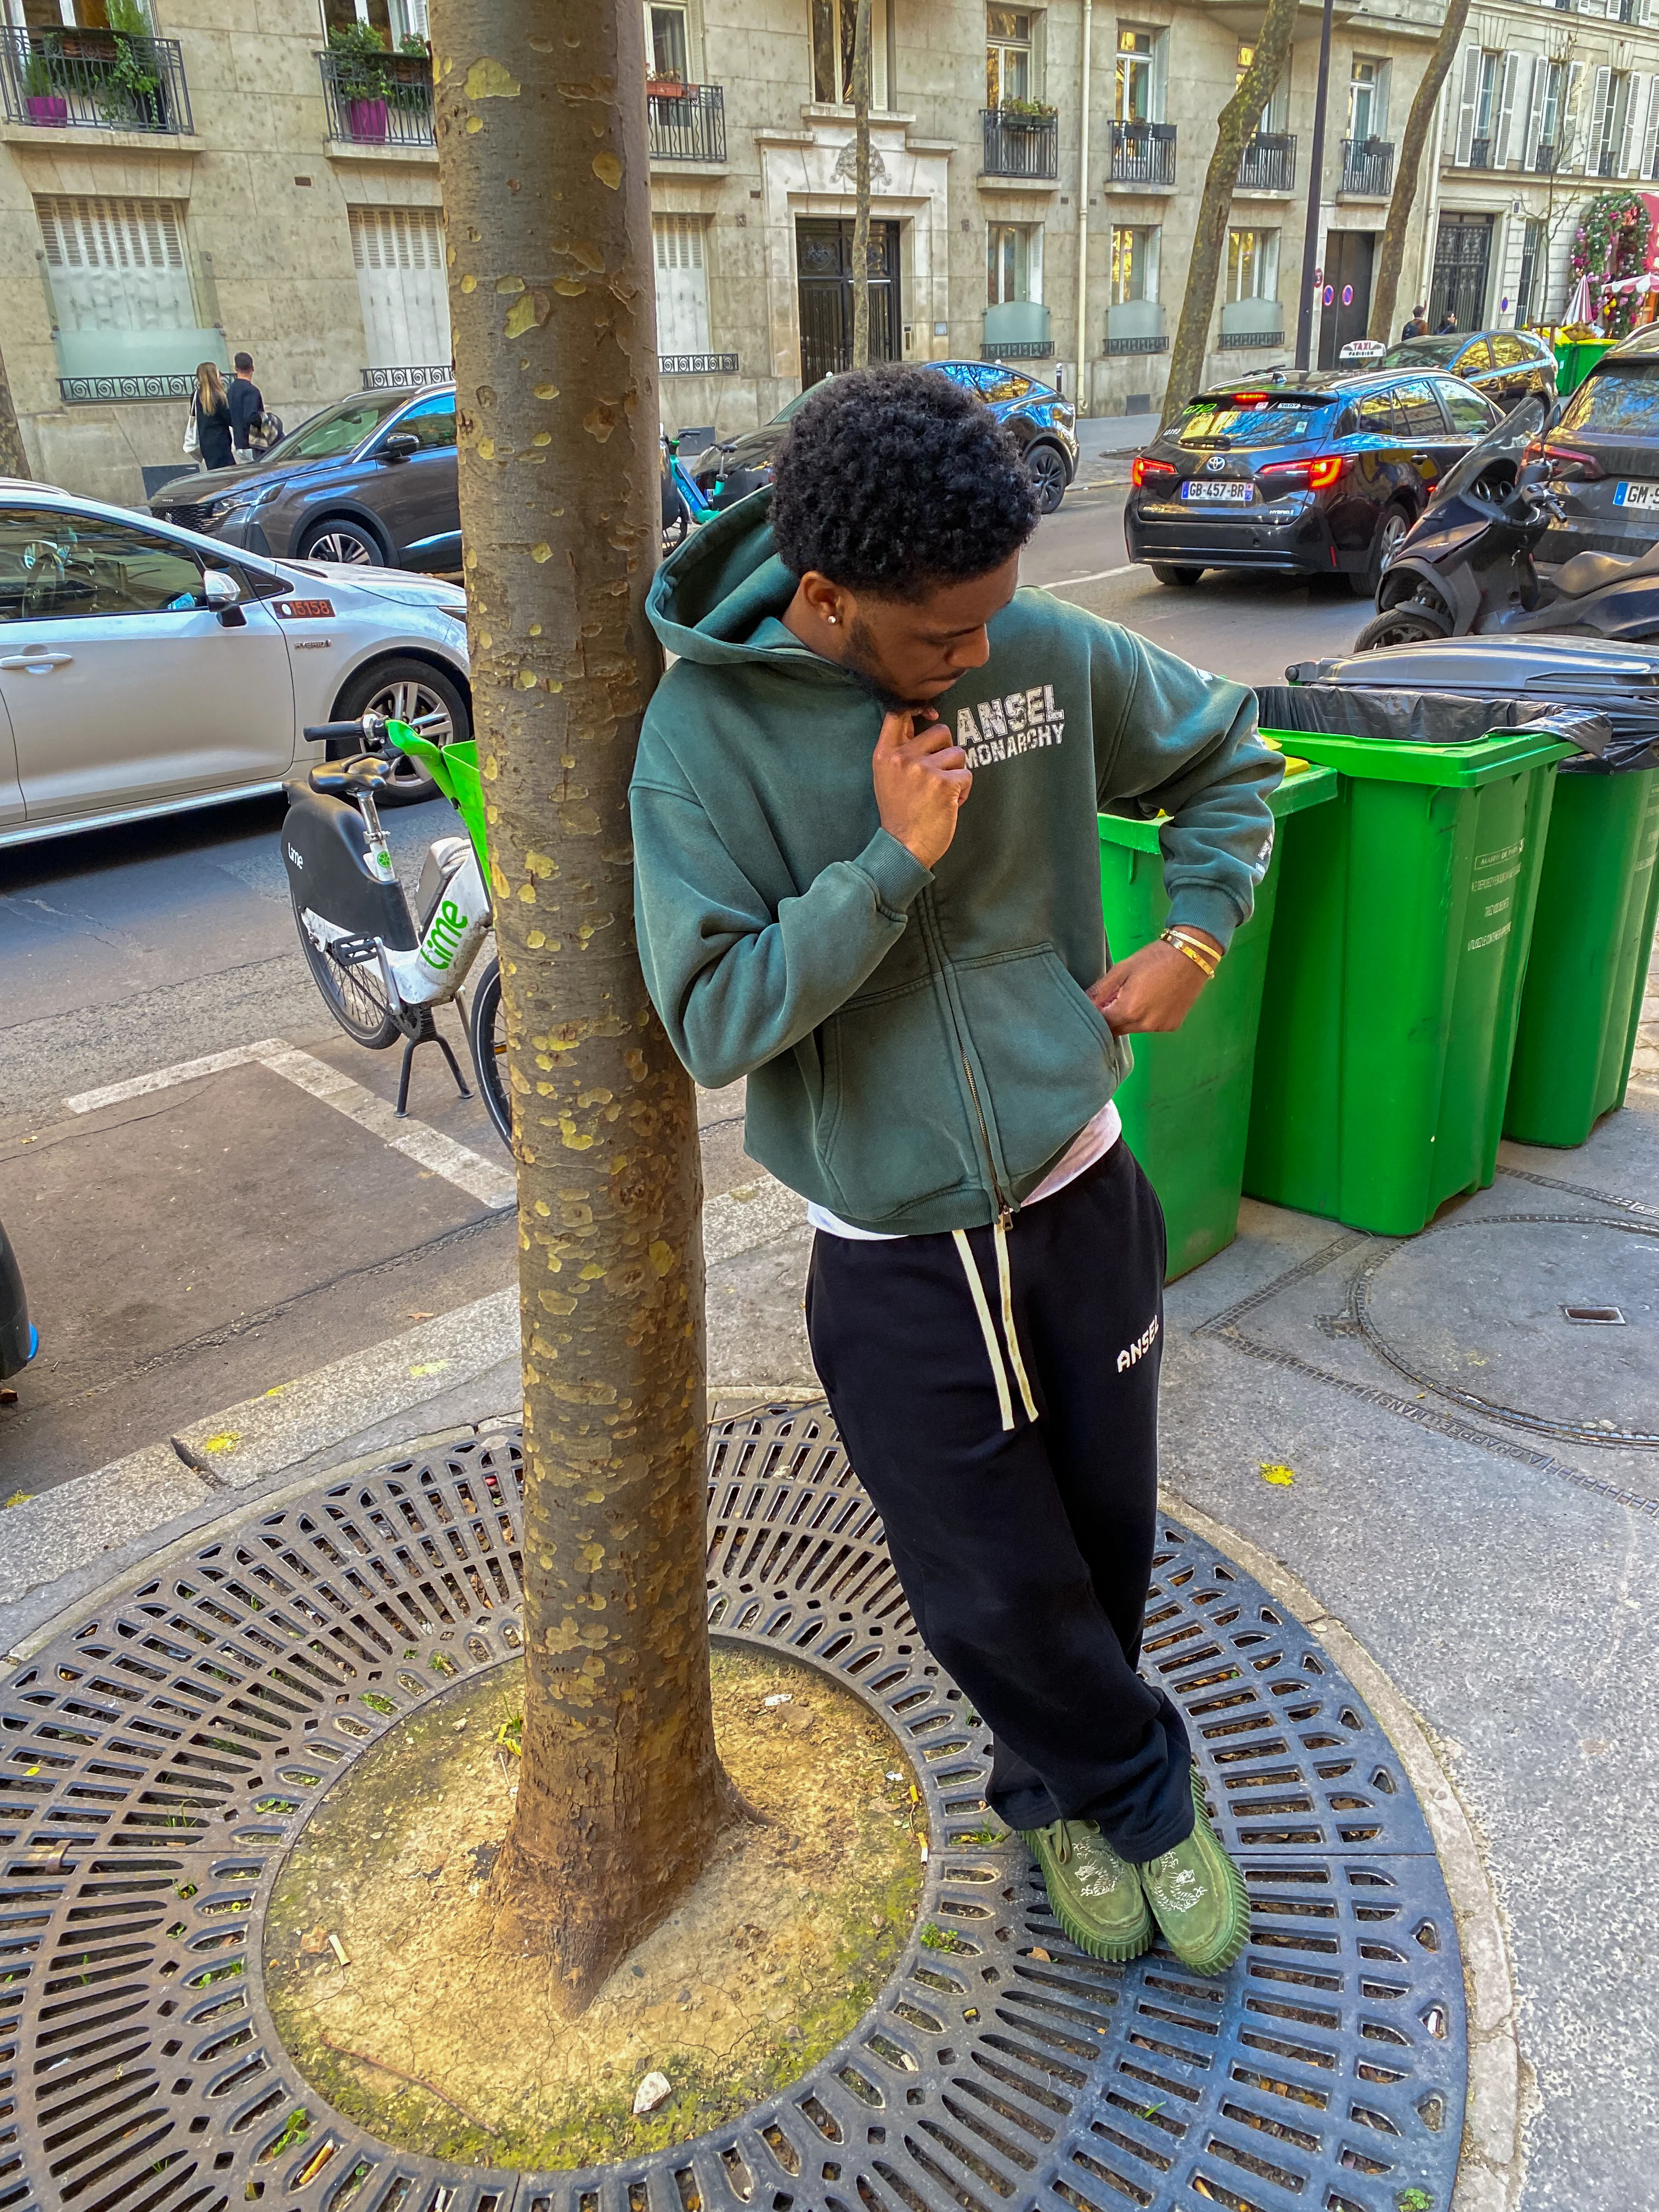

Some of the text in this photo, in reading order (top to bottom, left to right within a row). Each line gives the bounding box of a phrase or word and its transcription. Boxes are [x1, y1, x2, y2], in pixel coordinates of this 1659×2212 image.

[1353, 342, 1372, 351] TAXI
[1189, 483, 1244, 498] GB-457-BR
[290, 601, 330, 616] 15158
[957, 684, 1064, 747] ANSEL
[965, 723, 1065, 769] MONARCHY
[1117, 1315, 1159, 1373] ANSEL
